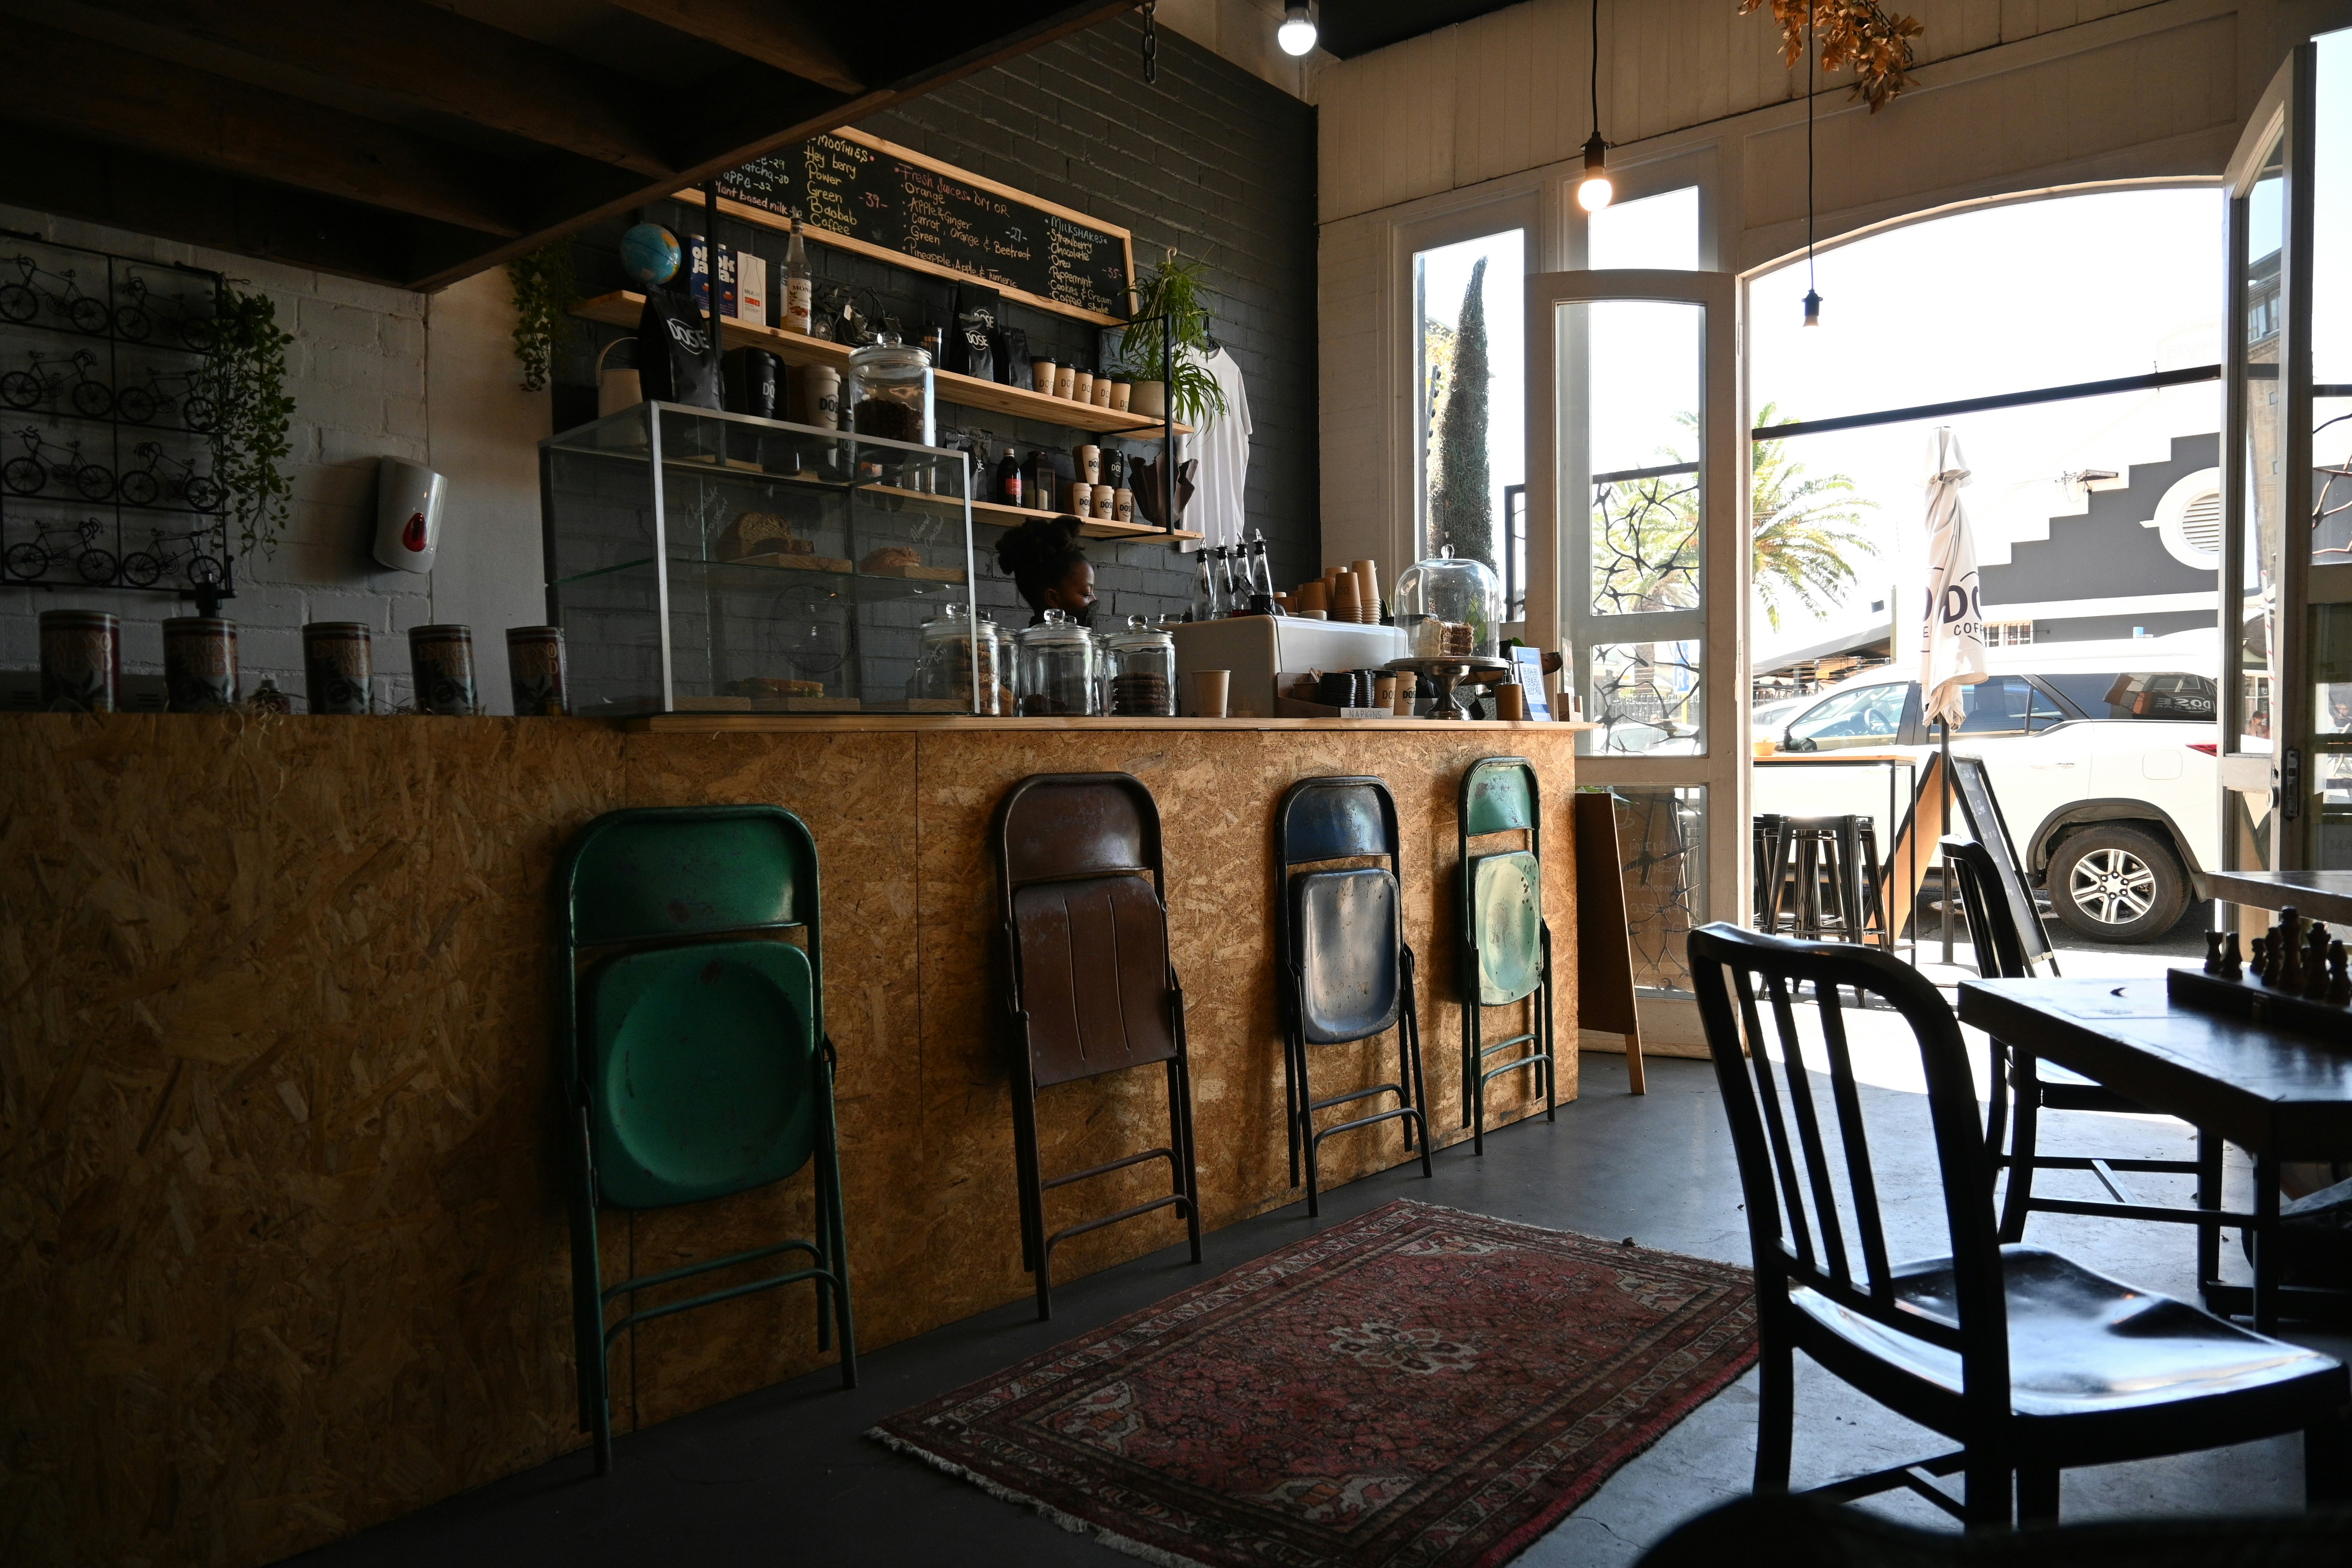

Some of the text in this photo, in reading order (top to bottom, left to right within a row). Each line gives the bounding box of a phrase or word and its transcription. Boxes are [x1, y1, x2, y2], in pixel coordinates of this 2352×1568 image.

[810, 135, 868, 163] MOOTHIES
[804, 144, 856, 180] Hey berry
[805, 161, 842, 186] Power
[898, 163, 933, 188] Fresh
[807, 181, 843, 204] Green
[905, 182, 945, 205] Orange
[740, 190, 768, 210] based
[770, 202, 788, 215] milk
[806, 196, 857, 225] Baobab
[810, 214, 851, 235] Coffee
[911, 225, 940, 246] Green
[950, 228, 980, 246] Orange
[1050, 228, 1092, 253] Strawberry
[1051, 242, 1090, 261] Chocolate
[792, 285, 811, 293] MON
[1050, 279, 1078, 296] Cookies
[1052, 290, 1083, 307] Coffee
[666, 319, 710, 350] DOSE
[965, 332, 988, 346] DOSE
[762, 381, 775, 399] DO
[1061, 378, 1074, 388] DOS
[819, 397, 838, 413] DOS
[1111, 464, 1121, 472] DOS
[1953, 622, 1984, 636] COFF
[1402, 690, 1416, 699] DOS
[1349, 710, 1382, 719] NAPKINS
